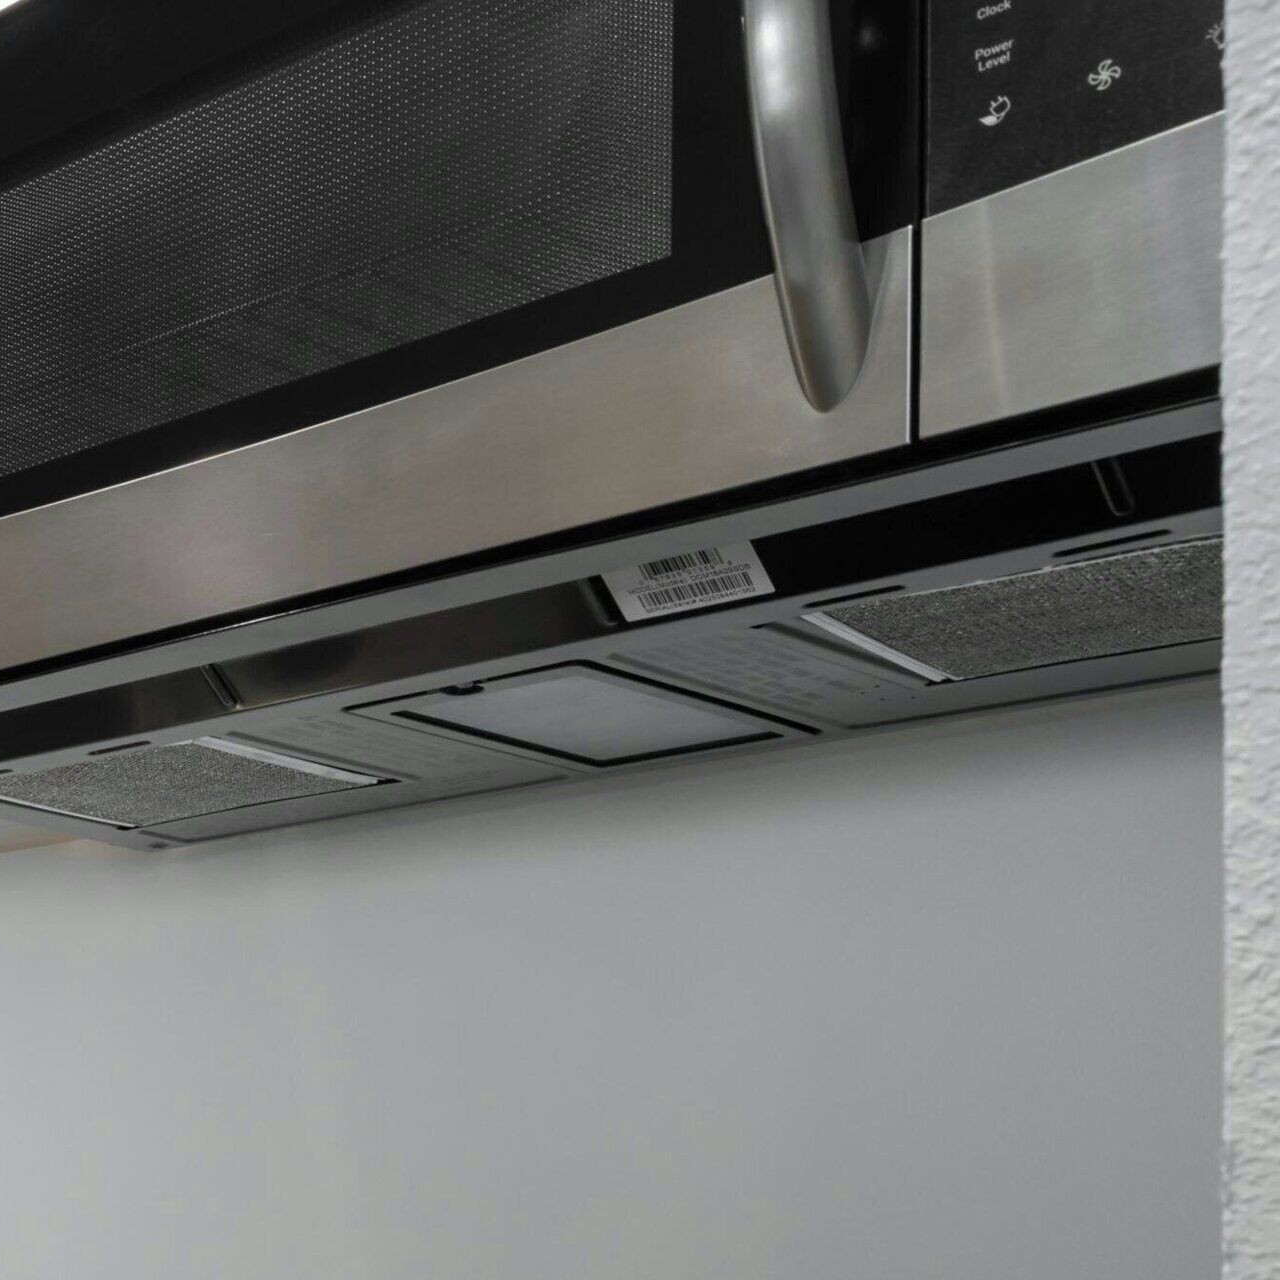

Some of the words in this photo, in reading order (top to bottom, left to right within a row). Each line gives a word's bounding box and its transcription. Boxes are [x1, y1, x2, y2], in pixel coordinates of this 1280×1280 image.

[977, 0, 1011, 19] Clock
[975, 39, 1014, 60] Power
[978, 50, 1010, 71] Level
